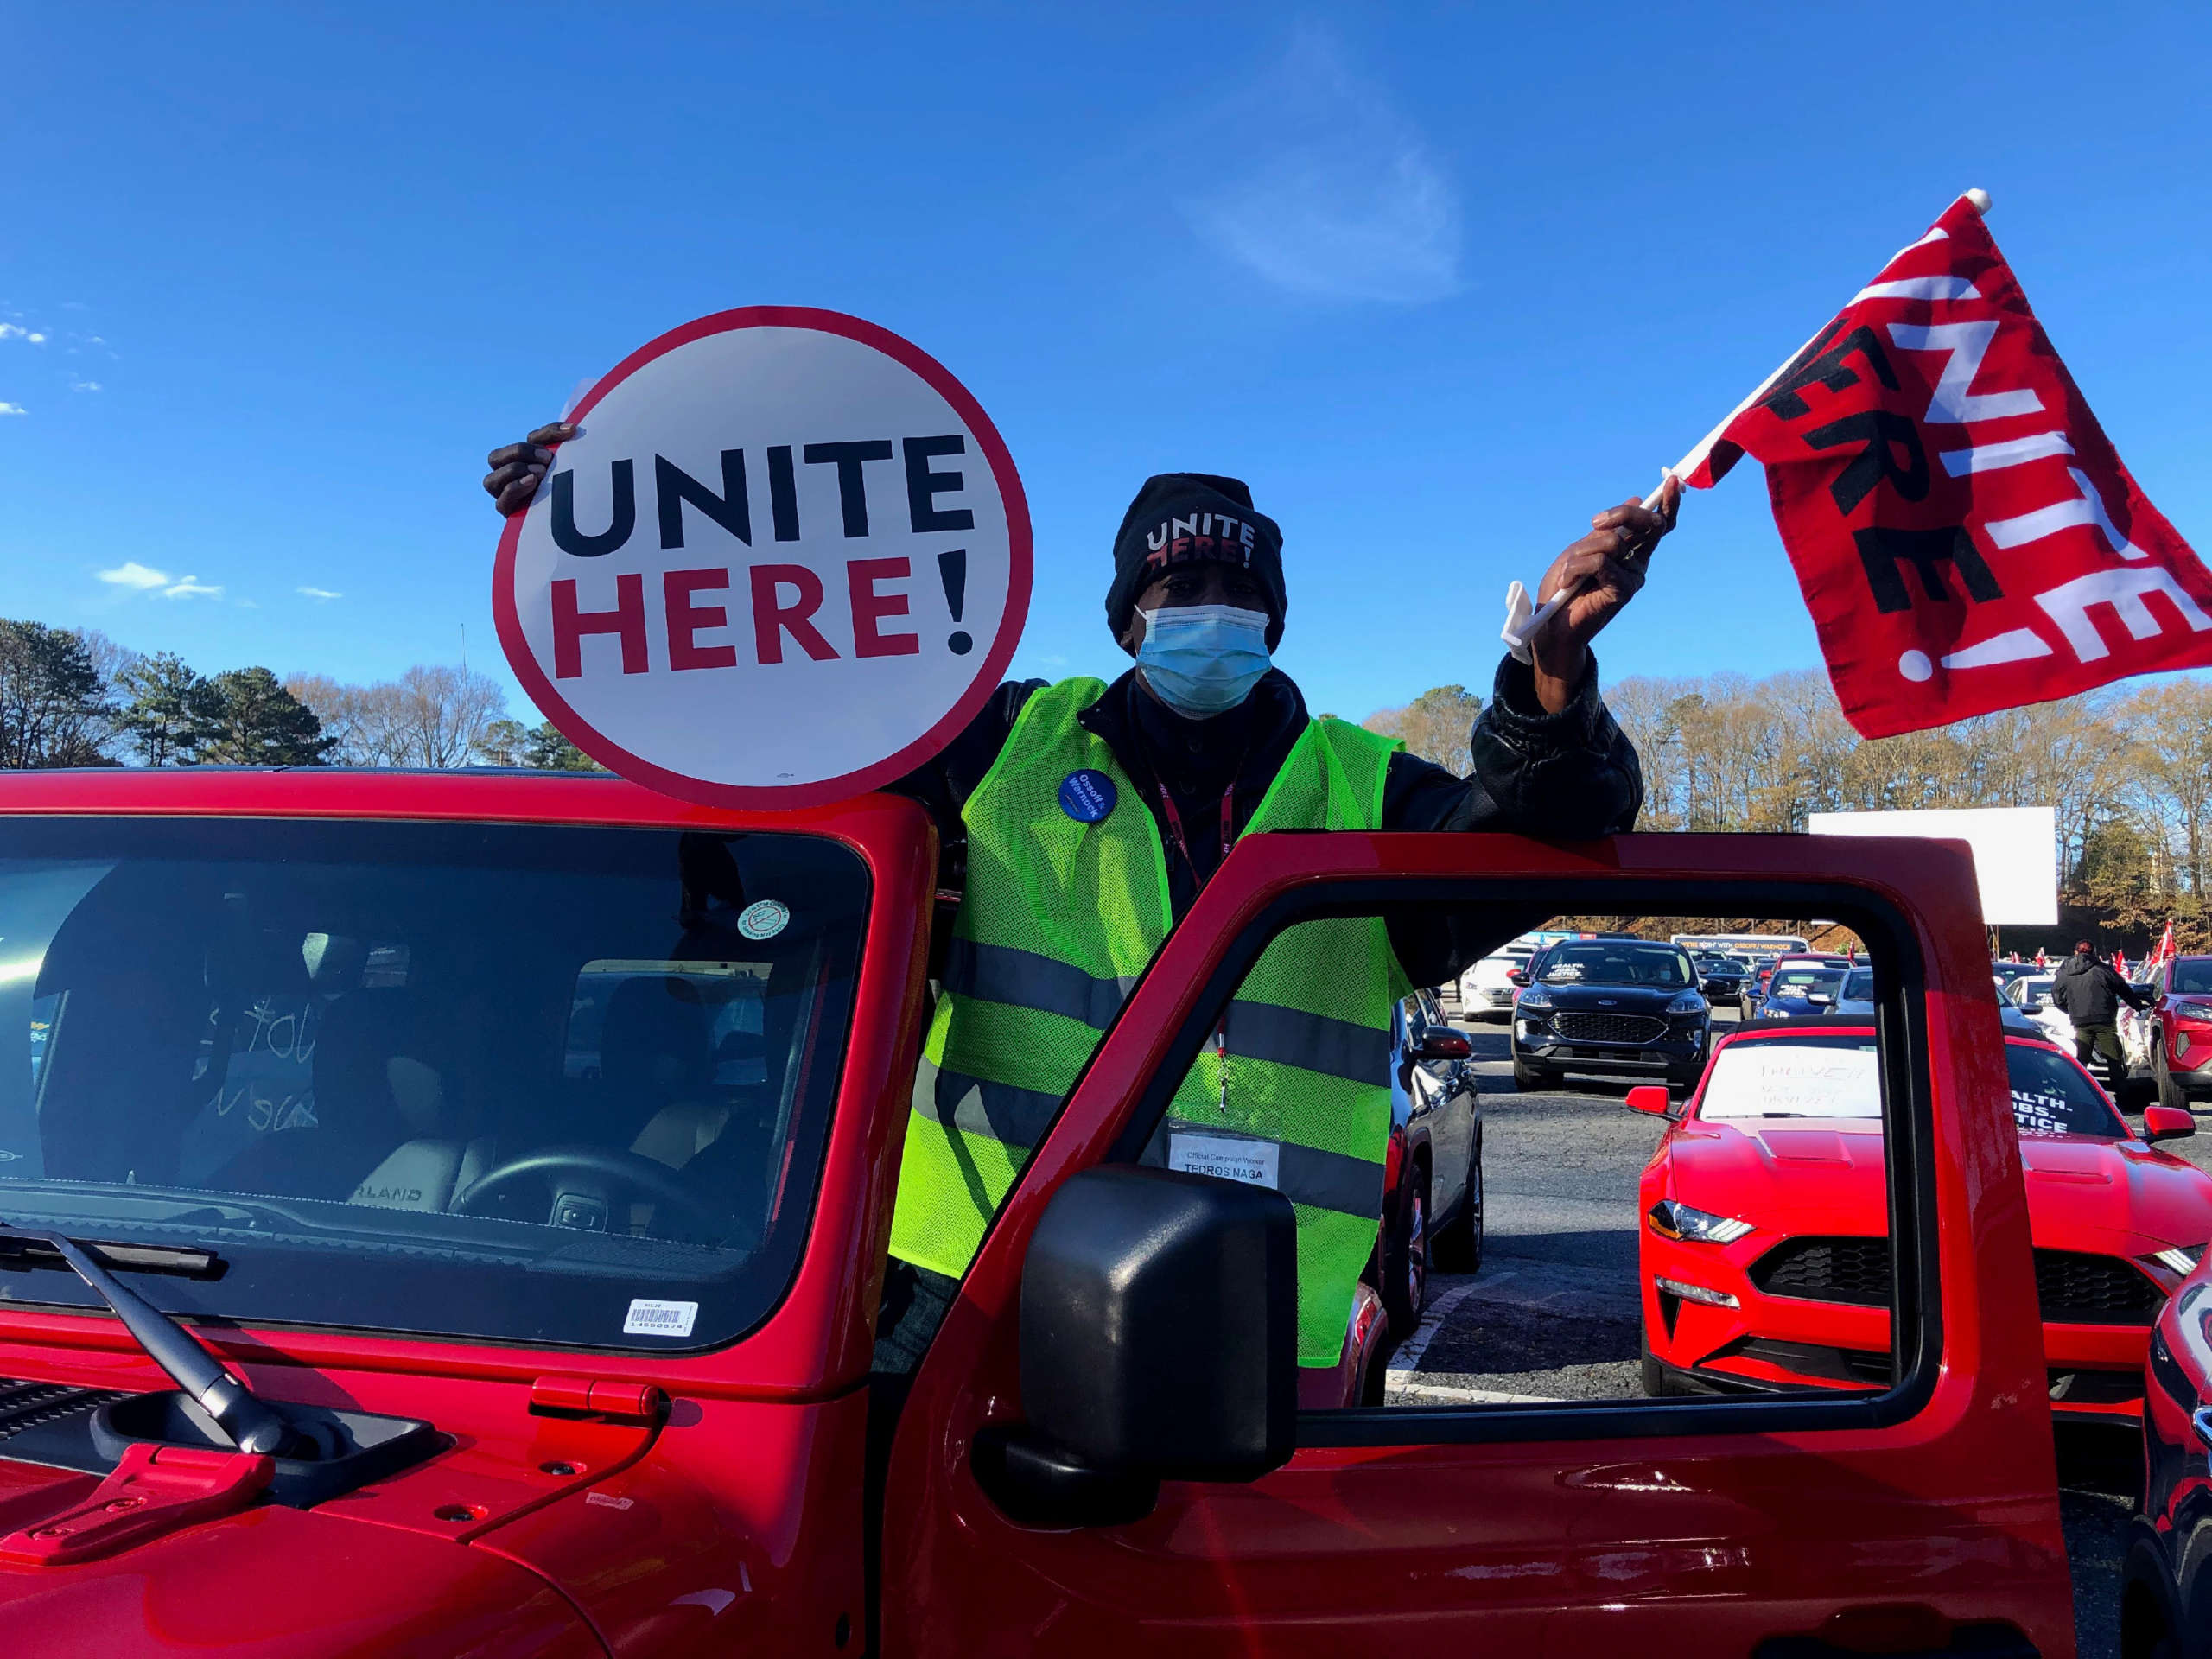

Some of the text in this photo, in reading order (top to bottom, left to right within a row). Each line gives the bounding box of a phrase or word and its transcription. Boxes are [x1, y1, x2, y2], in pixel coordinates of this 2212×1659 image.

[550, 434, 975, 557] UNITE
[1147, 512, 1255, 550] UNITE
[550, 549, 974, 679] HERE!
[1068, 777, 1099, 817] Warnock
[1079, 774, 1104, 803] Ossoff
[2011, 1090, 2073, 1112] ALTH.
[1185, 1164, 1263, 1179] TEDROS NAGA
